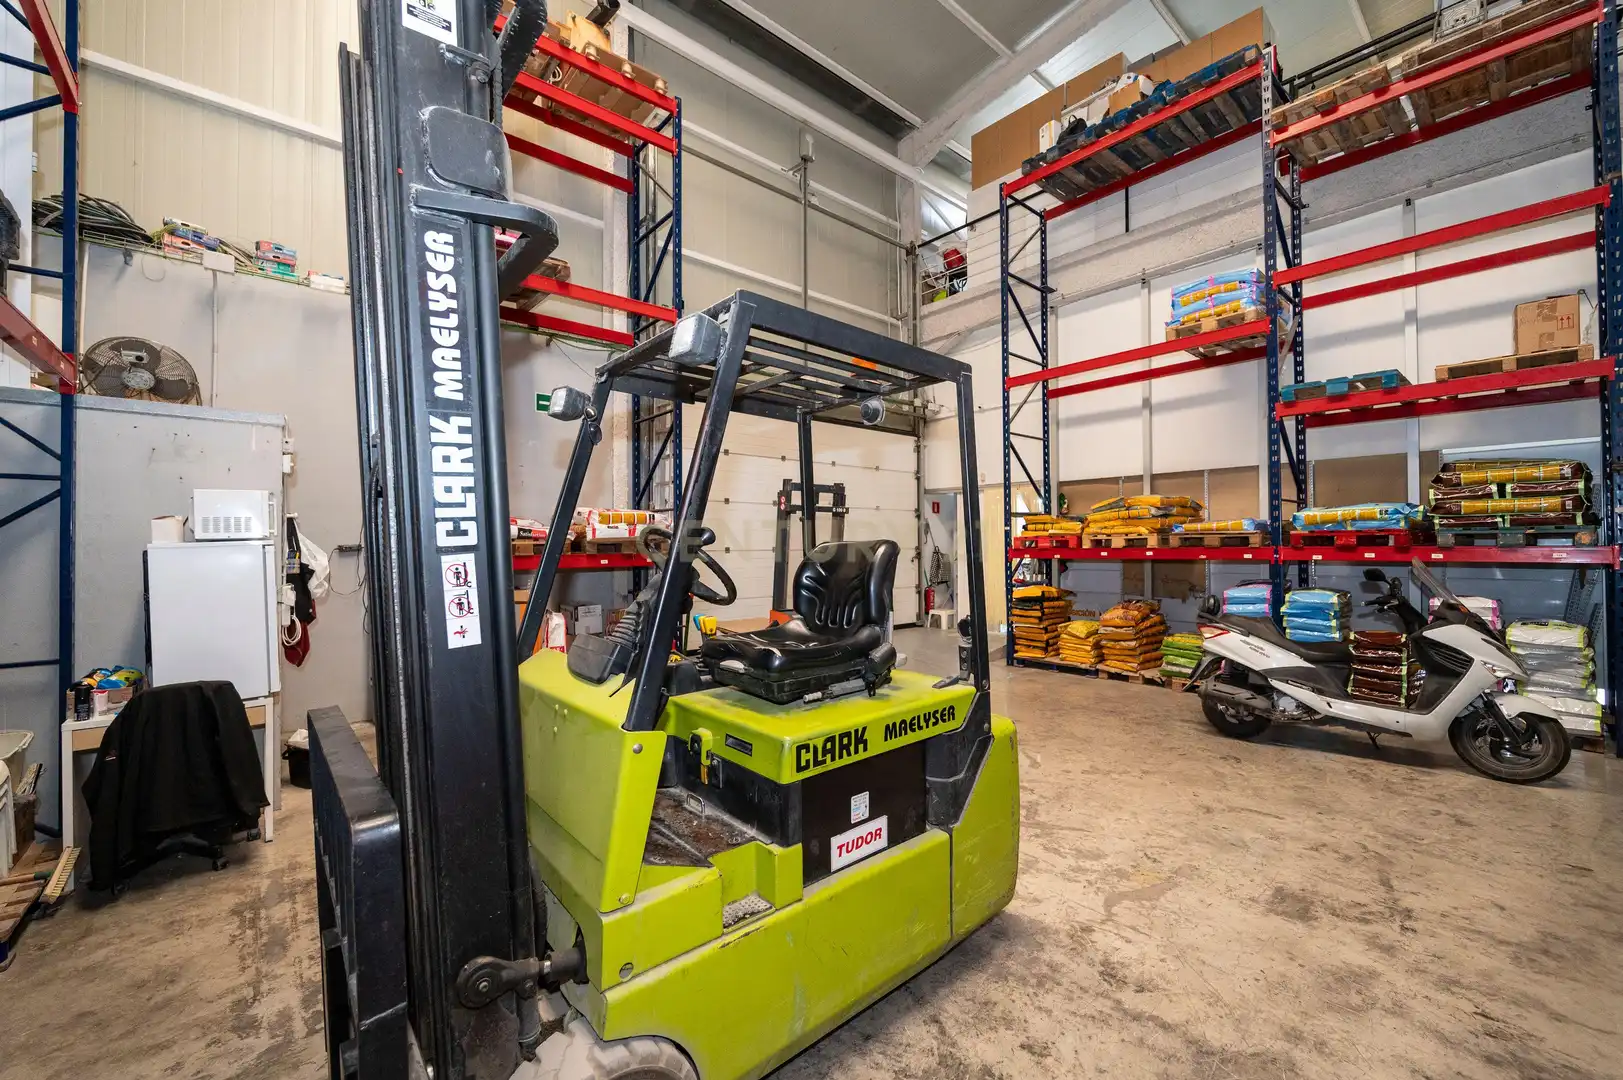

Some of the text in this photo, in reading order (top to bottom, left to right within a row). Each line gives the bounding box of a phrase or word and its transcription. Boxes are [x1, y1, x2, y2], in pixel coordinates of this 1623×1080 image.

[424, 230, 478, 547] CLARK MAELYSER
[795, 705, 956, 774] CLARK MAELYSER
[836, 827, 883, 858] TUDOR
